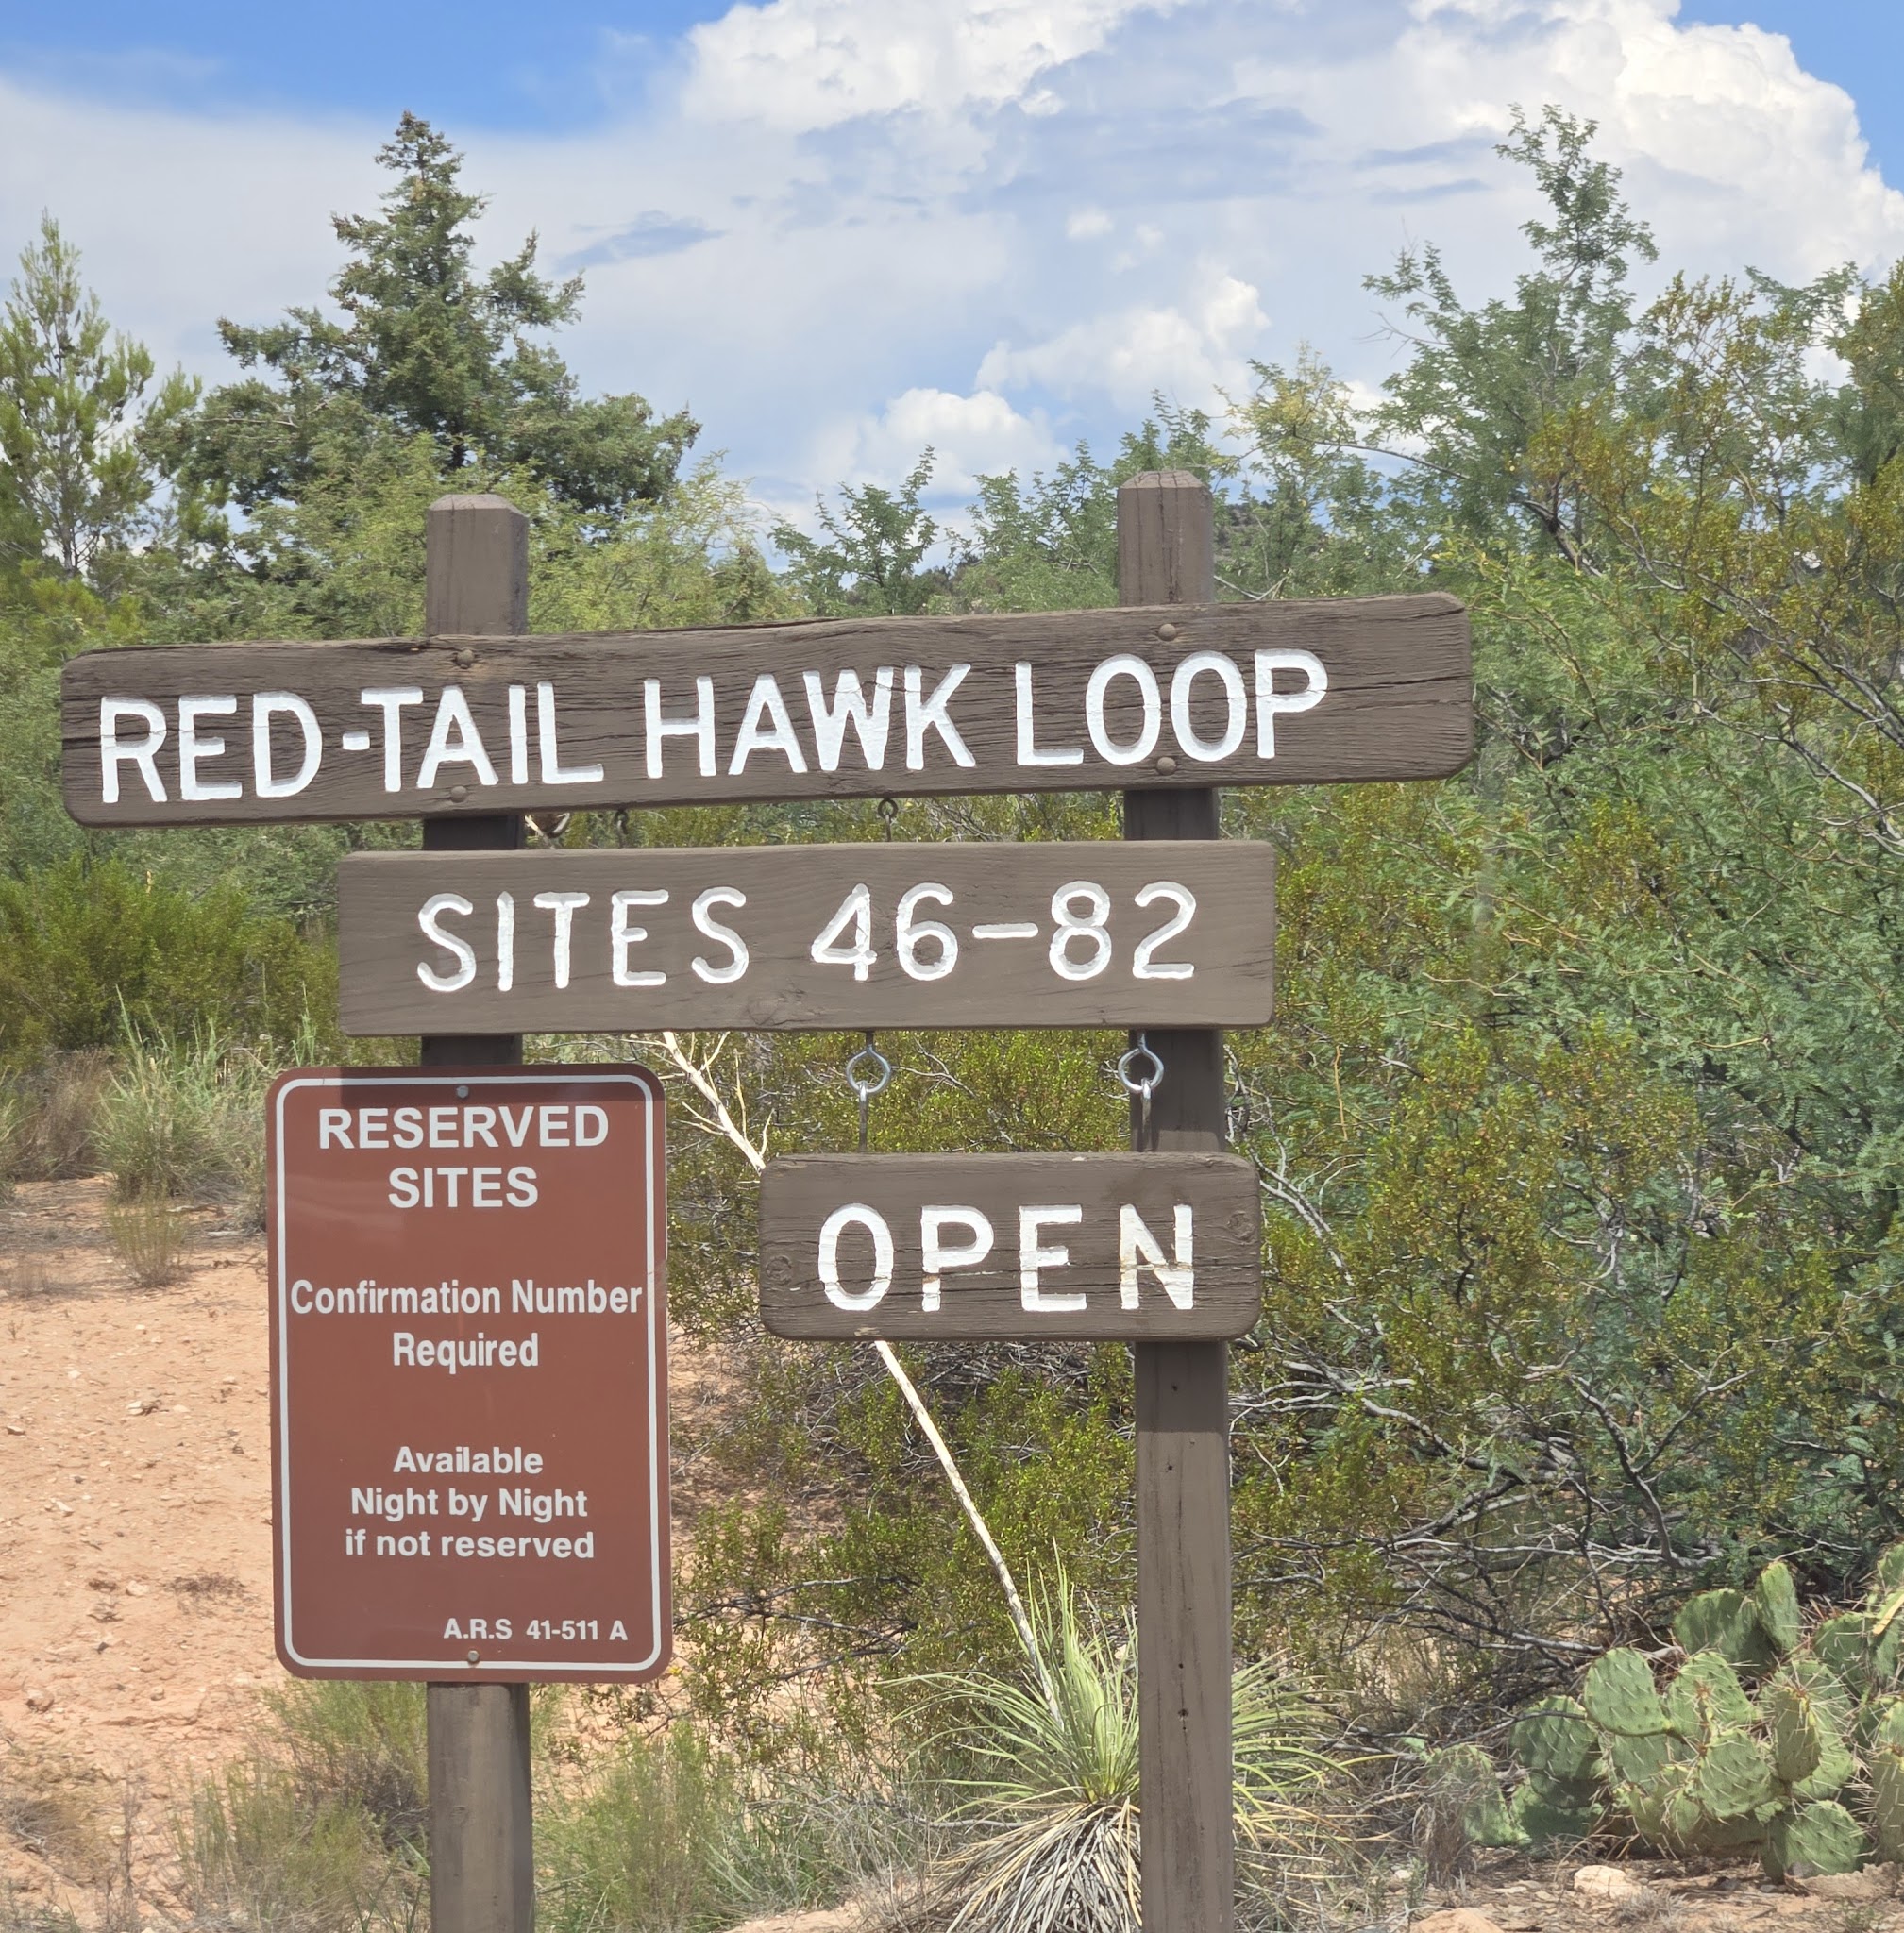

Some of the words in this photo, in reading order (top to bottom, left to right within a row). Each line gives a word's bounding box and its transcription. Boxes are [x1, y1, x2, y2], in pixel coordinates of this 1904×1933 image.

[100, 682, 604, 803] RED-TAIL
[644, 664, 976, 779] HAWK
[1016, 649, 1327, 765] LOOP
[417, 889, 749, 992] SITES
[811, 881, 1196, 981] 46-82
[320, 1106, 608, 1149] RESERVED
[389, 1167, 537, 1208] SITES
[818, 1203, 1194, 1312] OPEN
[291, 1280, 500, 1314] Confirmation
[513, 1280, 644, 1313] Number
[394, 1333, 538, 1374] Required
[394, 1446, 543, 1473] Available
[351, 1488, 438, 1521] Night
[449, 1488, 488, 1521] by
[499, 1488, 587, 1522] Night
[345, 1529, 367, 1555] if
[377, 1531, 431, 1556] not
[442, 1531, 595, 1558] reserved
[444, 1618, 513, 1639] A.R.S
[526, 1620, 598, 1640] 41-511
[609, 1621, 629, 1640] A
